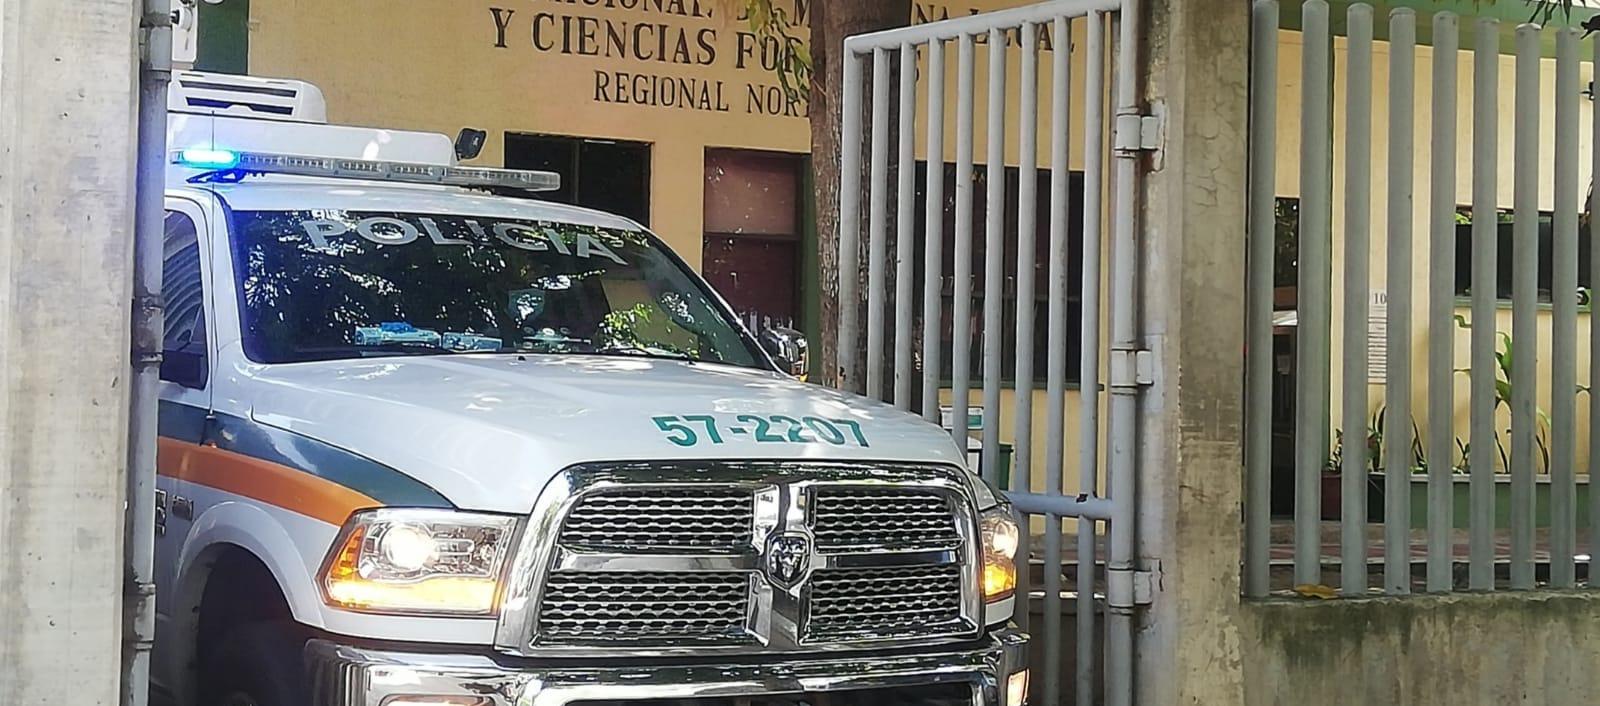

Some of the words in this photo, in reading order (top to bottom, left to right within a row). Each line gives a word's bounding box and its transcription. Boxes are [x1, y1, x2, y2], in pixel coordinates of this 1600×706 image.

[490, 8, 514, 49] Y
[533, 13, 717, 66] CIENCIAS
[593, 71, 729, 112] REGIONAL
[651, 415, 870, 448] 57-2207
